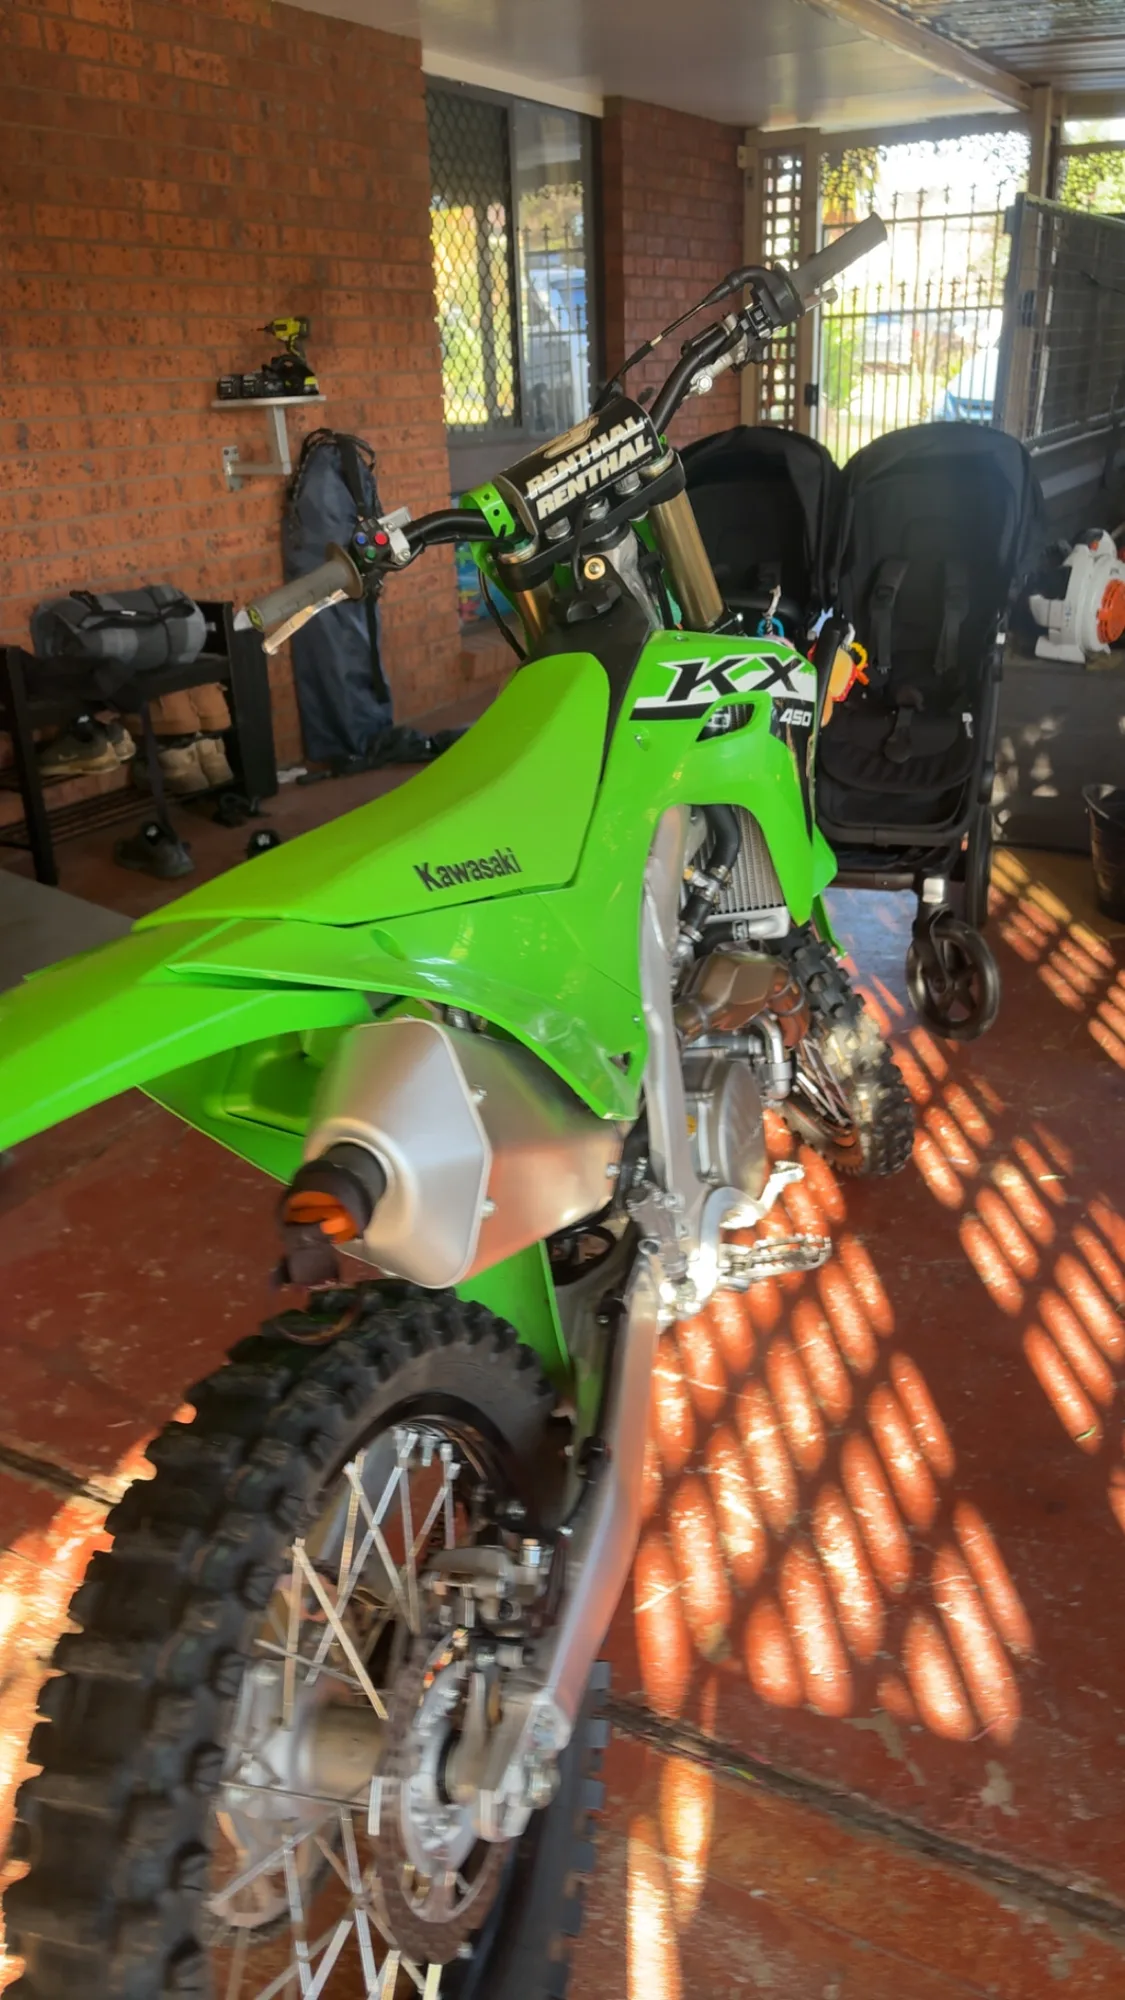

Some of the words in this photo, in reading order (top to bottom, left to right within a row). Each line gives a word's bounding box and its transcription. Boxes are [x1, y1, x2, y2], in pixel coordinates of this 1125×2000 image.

[524, 416, 646, 500] RENTHAL
[535, 434, 654, 521] RENTHAL
[664, 654, 803, 703] KX
[779, 707, 813, 728] 450
[412, 846, 524, 893] Kawasaki
